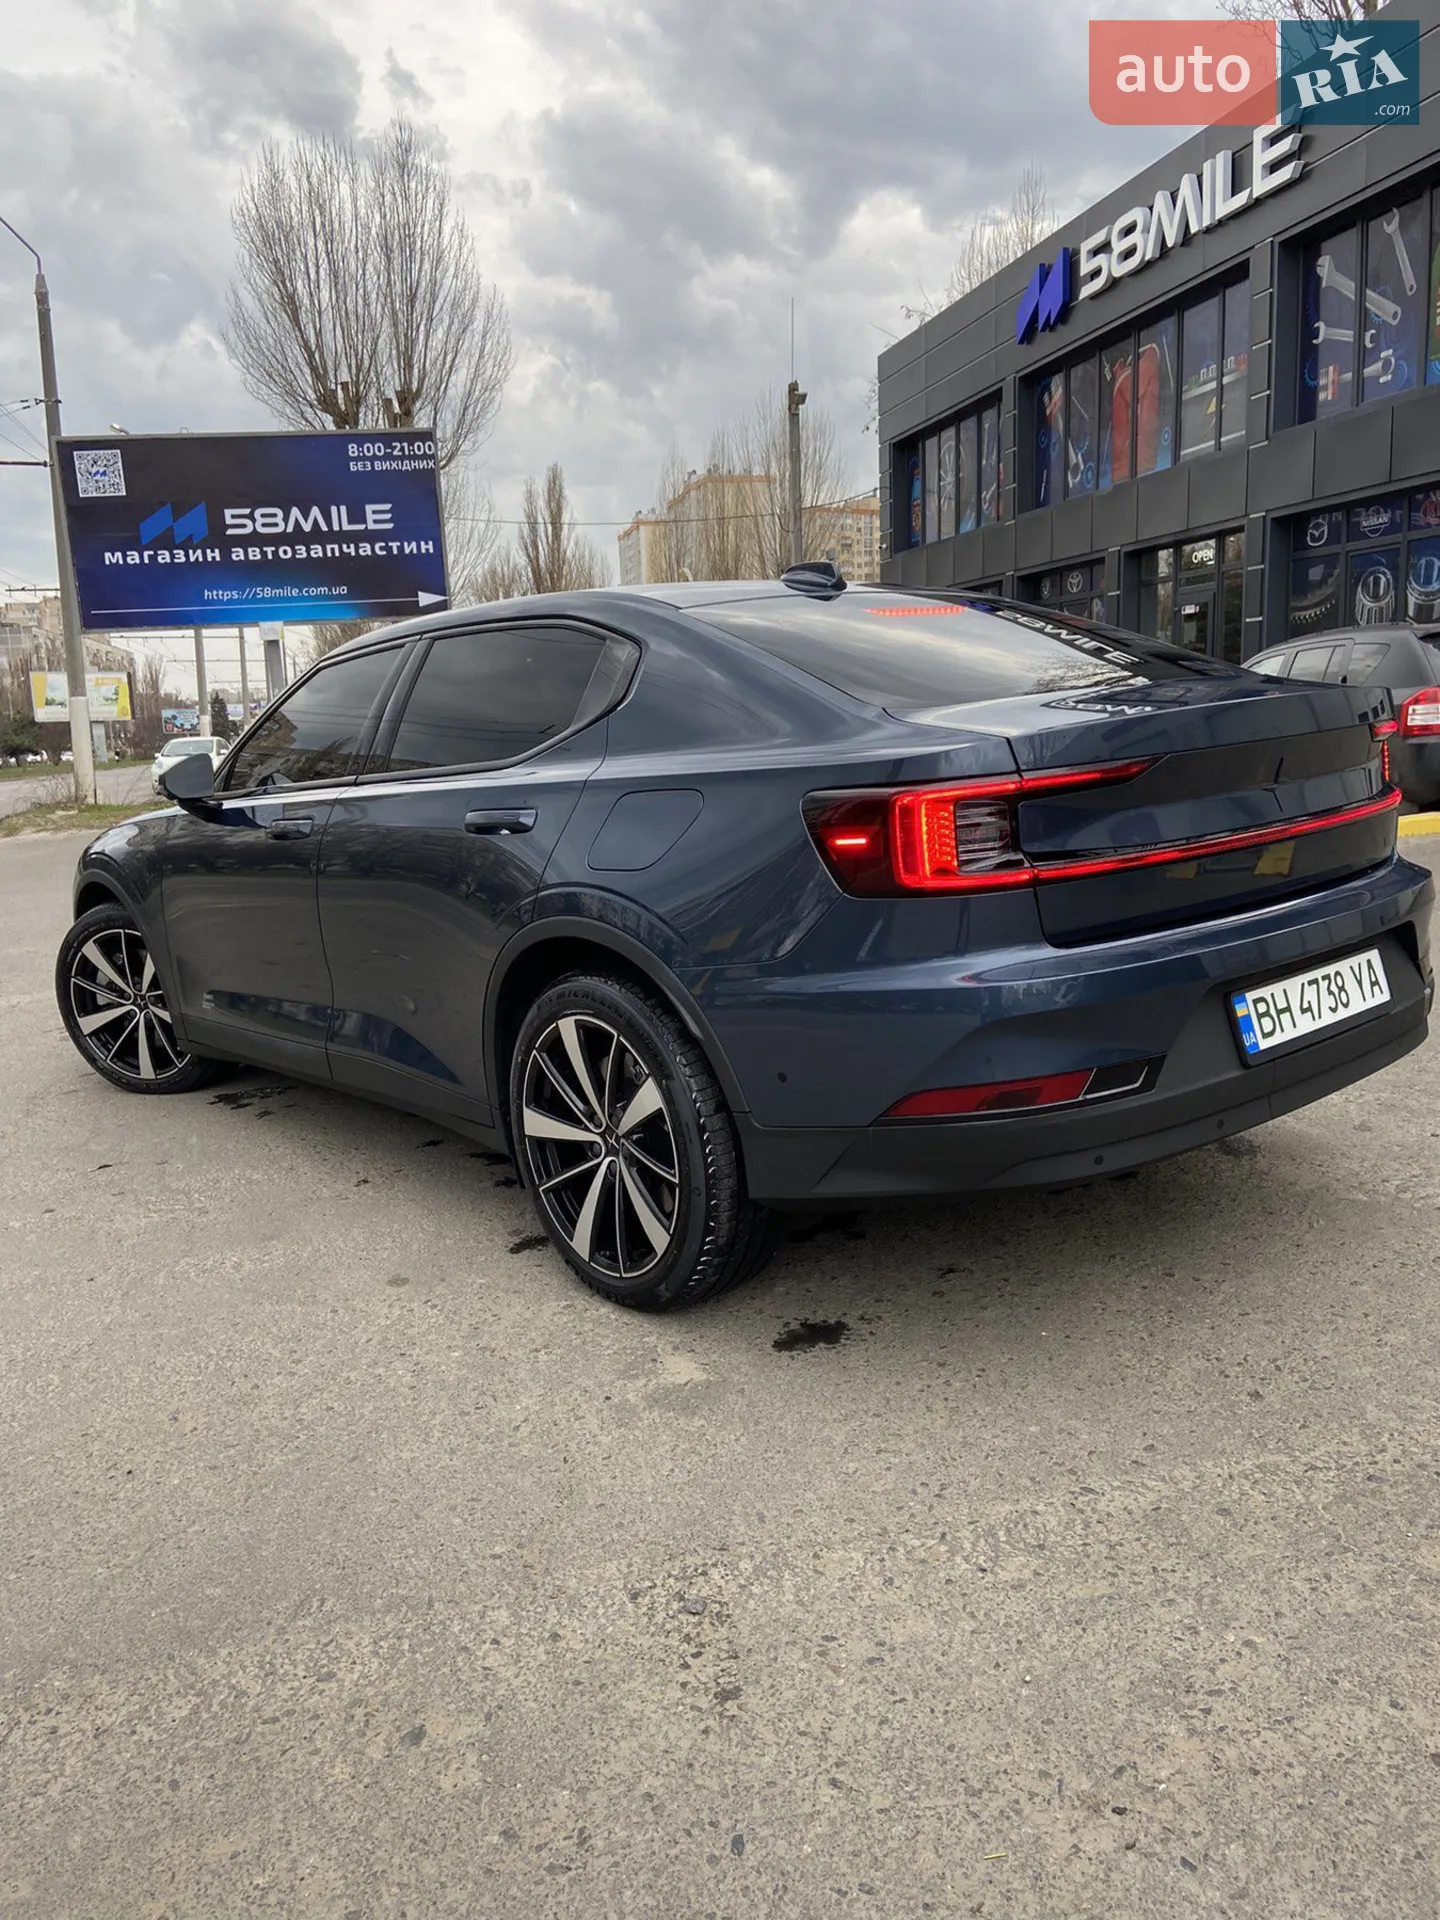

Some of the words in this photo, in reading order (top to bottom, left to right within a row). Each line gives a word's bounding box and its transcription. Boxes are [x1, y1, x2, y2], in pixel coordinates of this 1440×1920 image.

[1078, 106, 1305, 301] 58MILE
[347, 441, 435, 457] 8:00-21:00
[349, 461, 372, 472] БЕЗ
[374, 459, 436, 472] ВИХІДНИХ
[223, 503, 395, 536] 58MILE
[103, 546, 221, 565] магазин
[230, 539, 435, 562] автозапчастин
[1191, 548, 1215, 563] OPEN
[203, 584, 348, 600] https://58mile.com.ua
[1252, 988, 1297, 1039] BH
[1299, 970, 1350, 1022] 4738
[1349, 958, 1384, 1002] YA
[1243, 1033, 1257, 1046] UA
